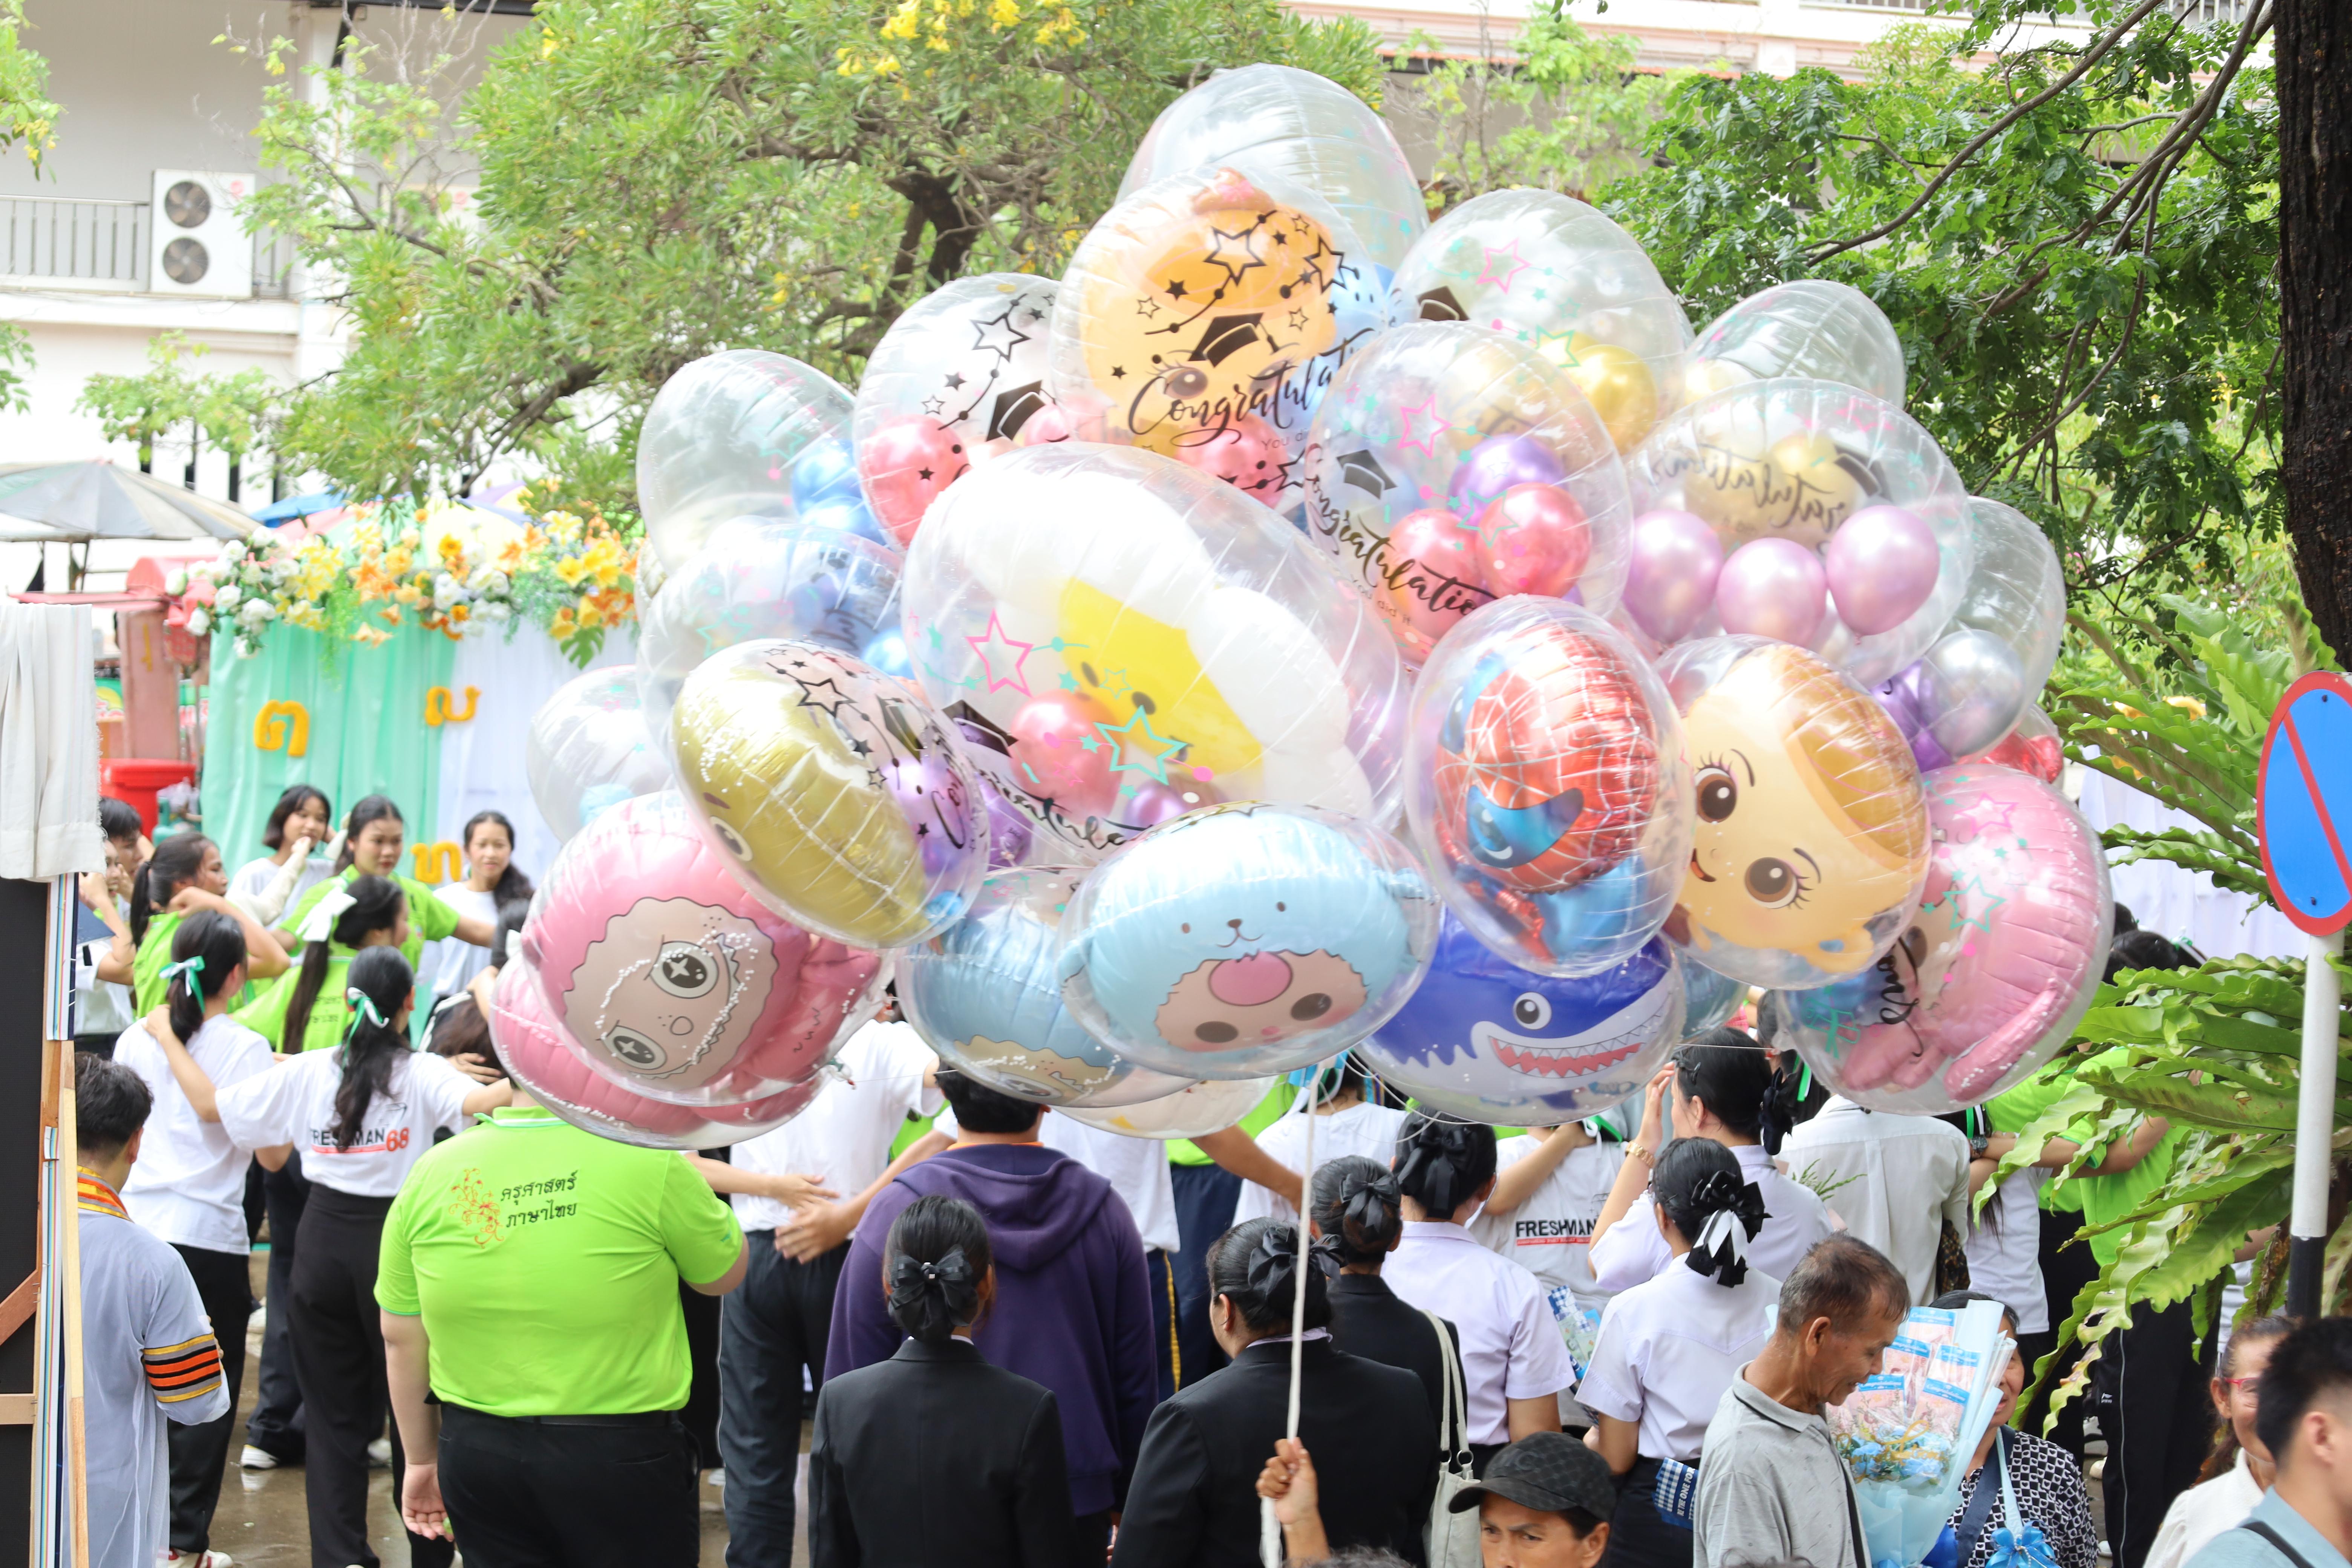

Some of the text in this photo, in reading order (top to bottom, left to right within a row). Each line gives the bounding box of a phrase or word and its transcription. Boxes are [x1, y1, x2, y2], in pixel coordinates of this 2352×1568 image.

[1128, 327, 1375, 447] Congratulat
[1304, 443, 1499, 616] Congratulatio
[386, 1127, 409, 1152] 68
[500, 1170, 578, 1205] ครุศาสตร์
[506, 1199, 577, 1228] ภาษาไทย
[1516, 1219, 1599, 1237] FRESHMAN
[1892, 1341, 1928, 1353] ongratulations
[1684, 1467, 1696, 1483] FOR
[1680, 1483, 1690, 1500] ONE
